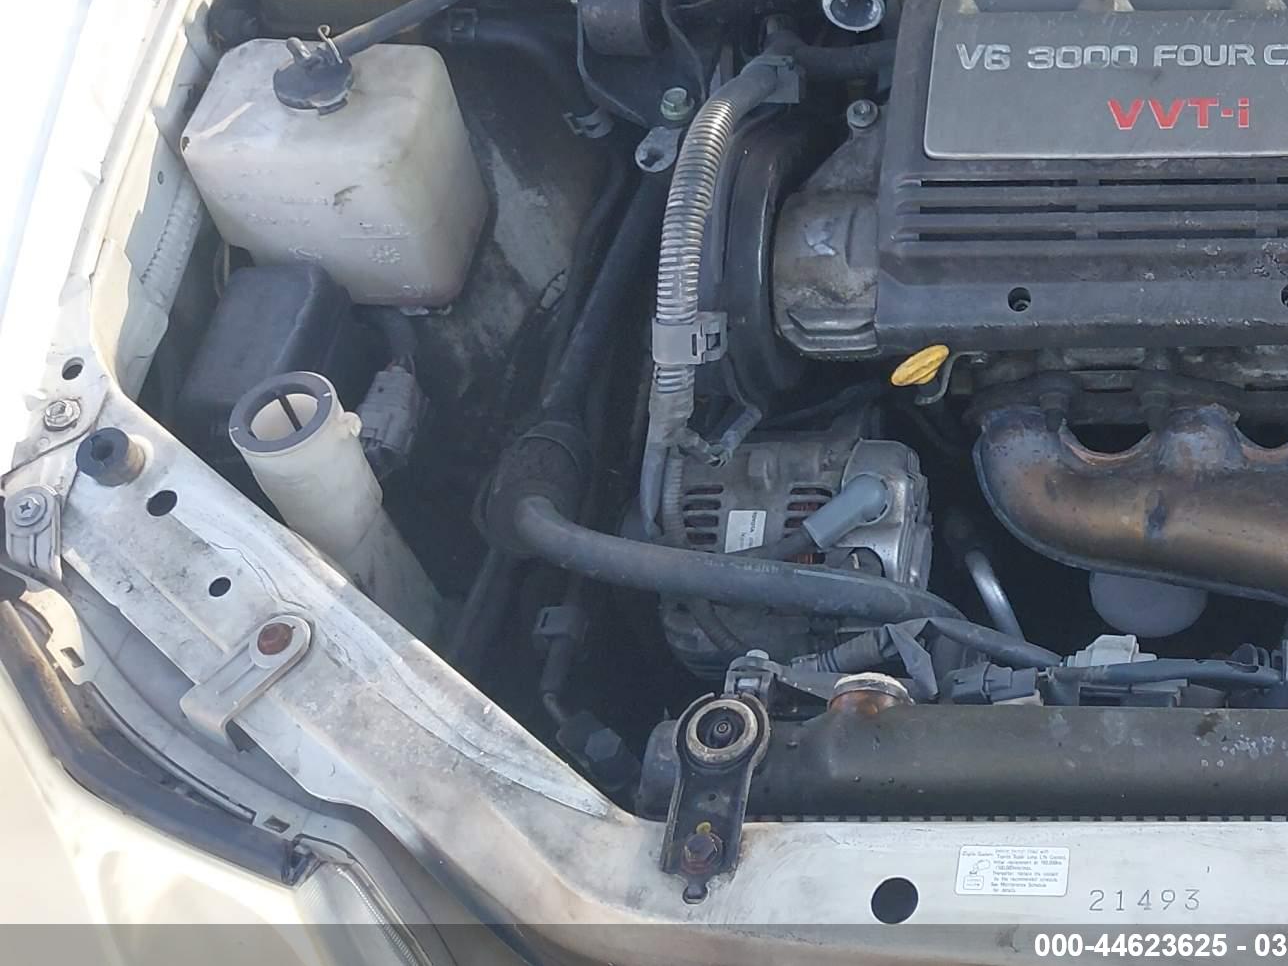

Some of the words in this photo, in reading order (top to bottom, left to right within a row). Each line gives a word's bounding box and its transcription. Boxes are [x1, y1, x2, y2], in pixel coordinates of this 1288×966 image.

[956, 43, 1011, 71] V6
[1026, 45, 1138, 70] 3000
[1153, 43, 1256, 67] FOUR
[1089, 889, 1200, 911] 21493
